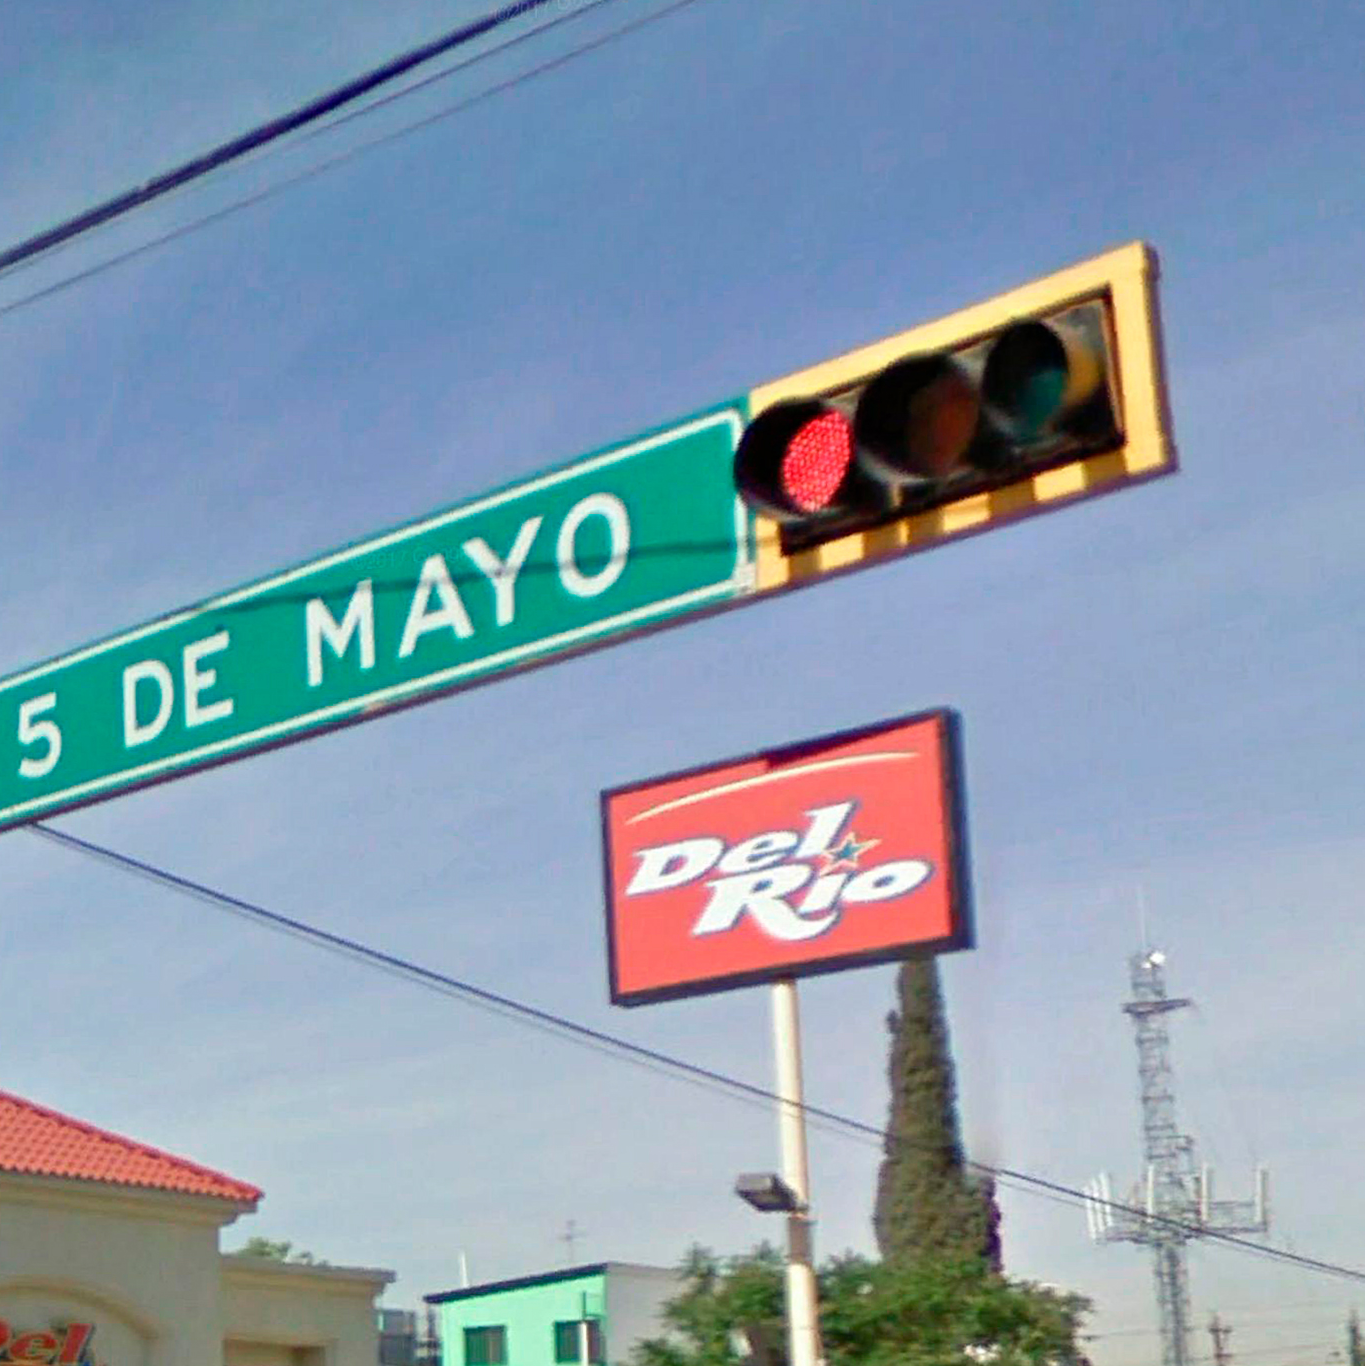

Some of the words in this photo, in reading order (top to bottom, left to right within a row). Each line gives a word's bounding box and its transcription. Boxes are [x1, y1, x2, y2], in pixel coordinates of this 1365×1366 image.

[16, 690, 63, 779] 5
[121, 630, 234, 748] DE
[303, 491, 632, 688] MAYO
[624, 799, 861, 897] Del
[690, 859, 936, 942] Rio
